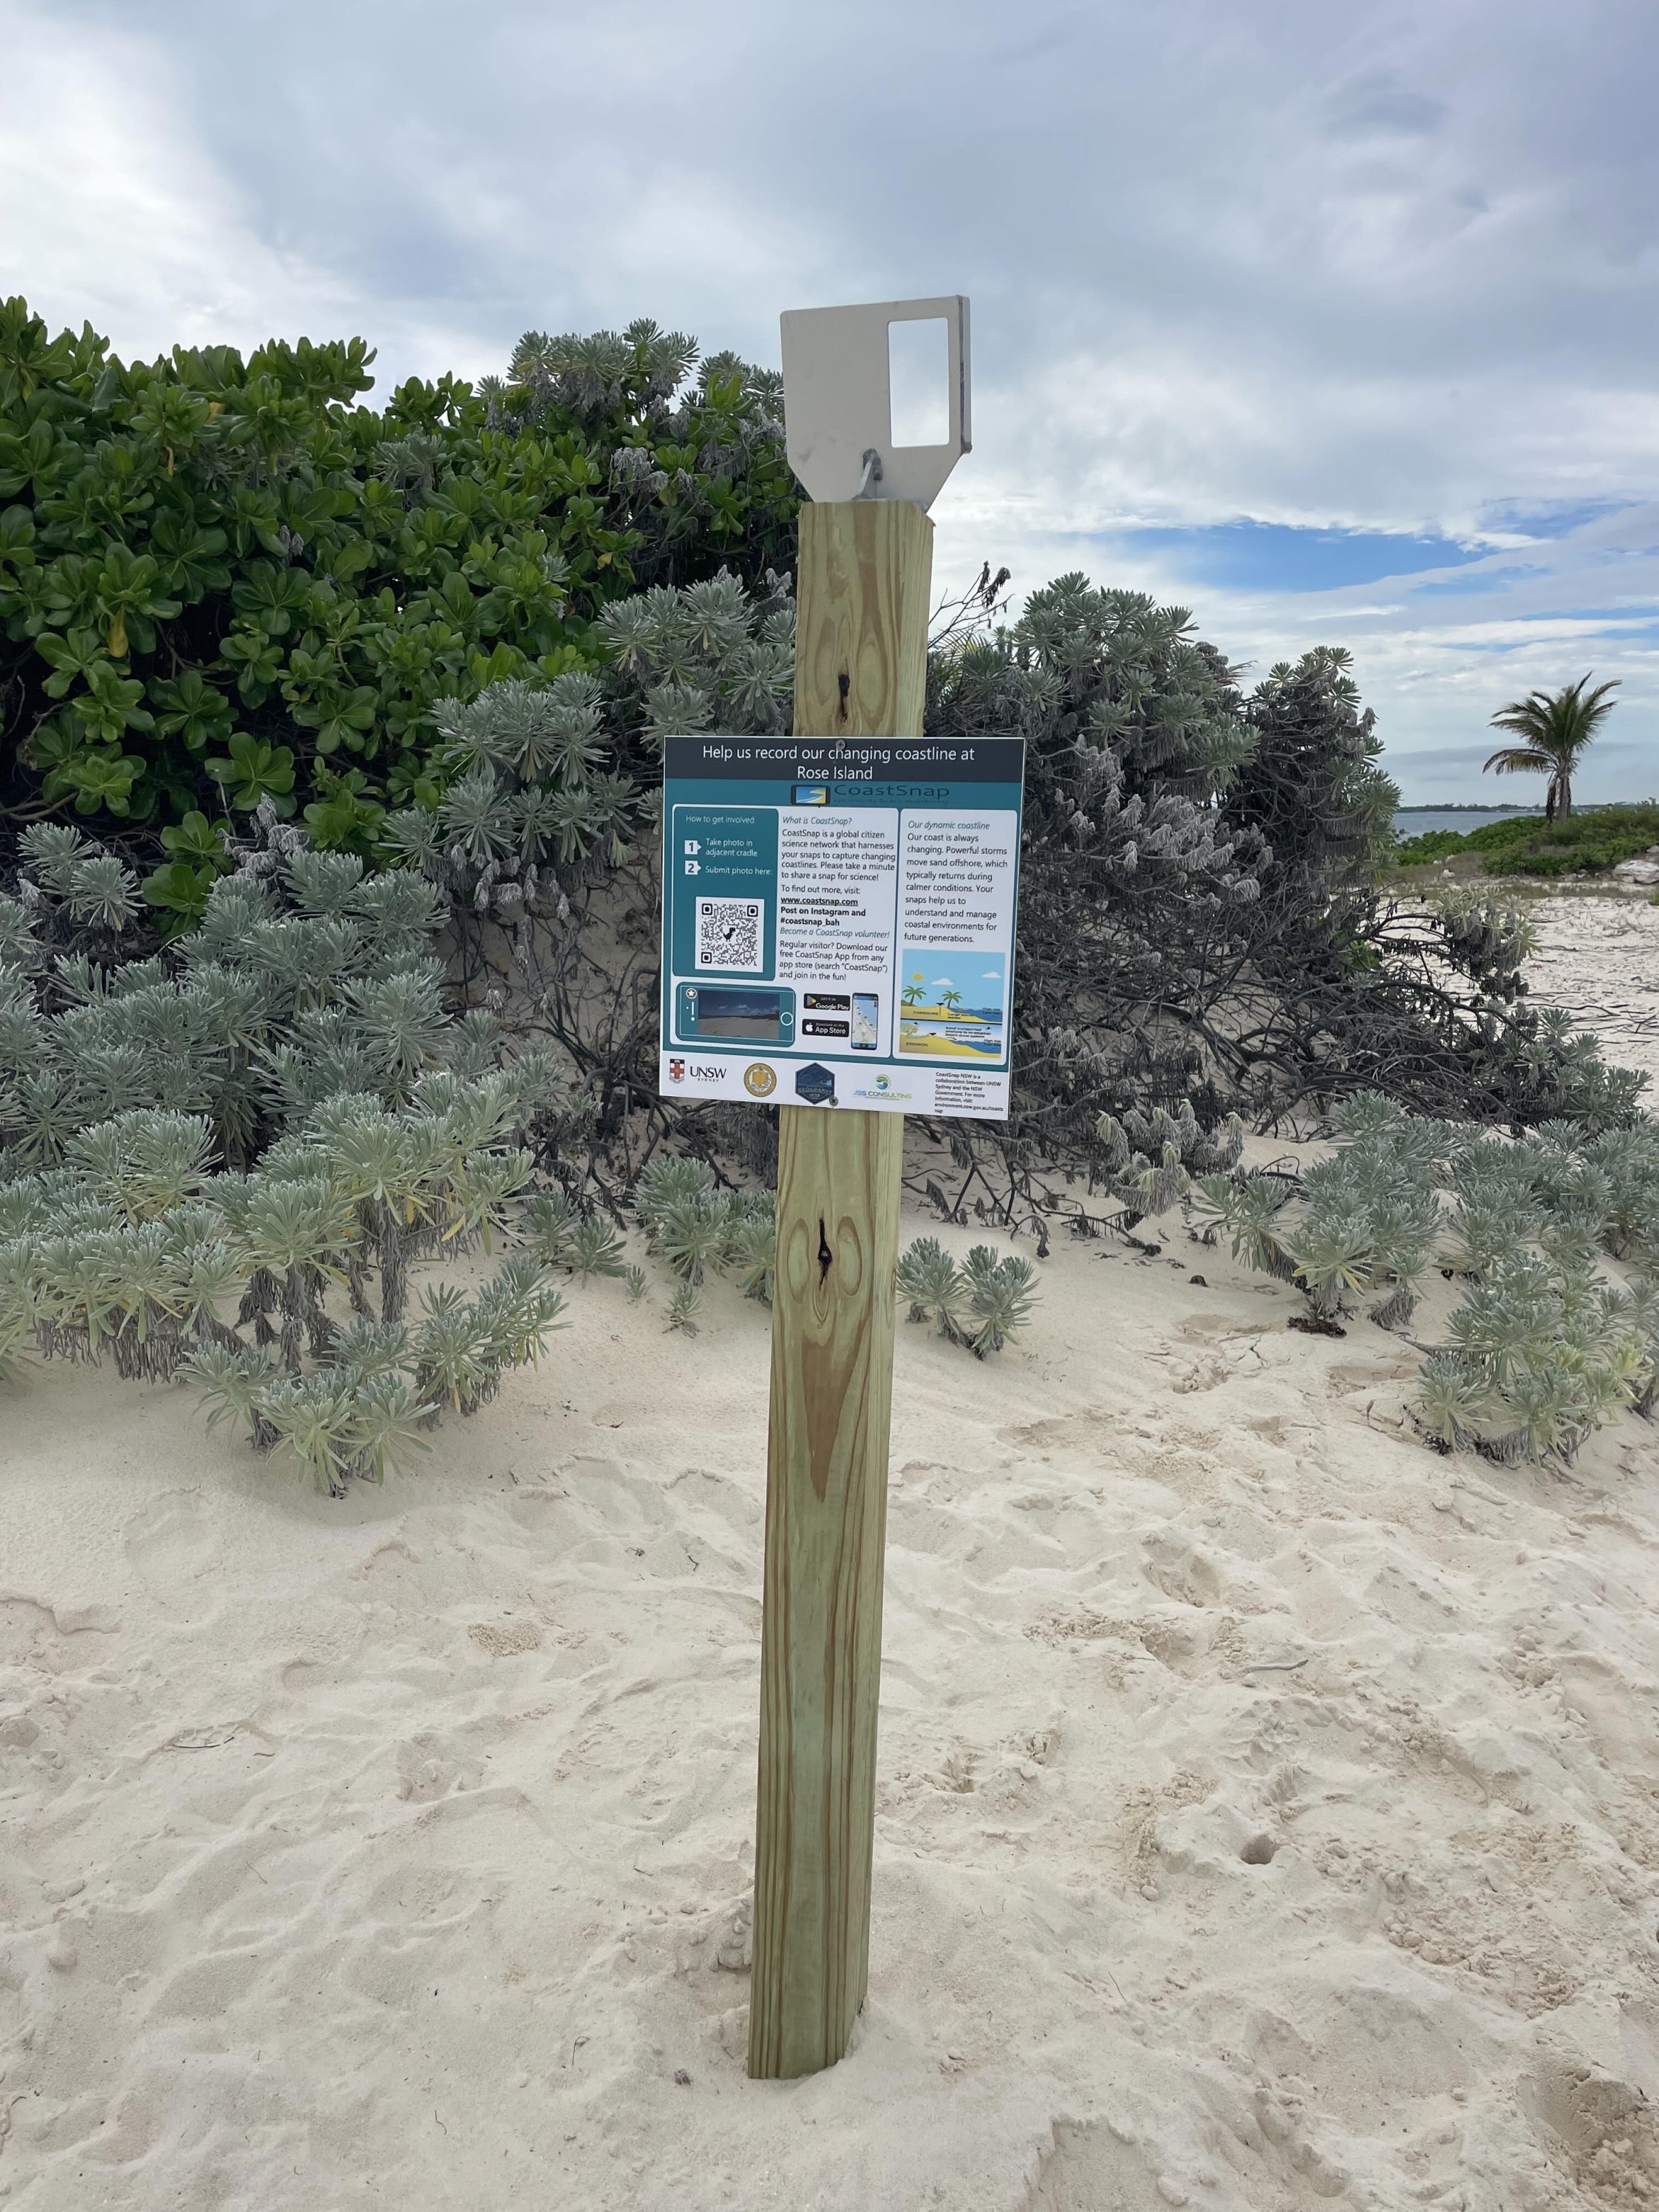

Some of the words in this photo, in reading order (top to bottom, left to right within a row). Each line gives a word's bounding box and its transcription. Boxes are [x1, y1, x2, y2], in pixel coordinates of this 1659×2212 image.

[703, 744, 732, 761] Help
[737, 748, 751, 759] us
[756, 746, 797, 759] record
[802, 749, 825, 759] our
[829, 746, 890, 763] changing
[895, 747, 956, 760] coastline
[961, 747, 975, 760] at
[798, 766, 829, 779] Rose
[834, 766, 873, 779] Island
[835, 785, 949, 798] CoastSnap
[811, 817, 851, 826] CoastSnap?
[908, 820, 922, 829] Our
[925, 821, 956, 830] dynamic
[782, 830, 820, 838] CoastSnap
[954, 834, 979, 843] always
[688, 842, 693, 852] 1
[907, 845, 944, 855] changing.
[949, 859, 983, 868] offshore,
[688, 864, 694, 873] 2
[906, 871, 937, 881] typically
[968, 873, 993, 882] during
[781, 898, 859, 906] www.coastsnap.com
[929, 896, 945, 905] help
[811, 908, 849, 917] Instagram
[905, 908, 947, 917] understand
[966, 911, 997, 920] manage
[781, 917, 839, 927] #coastsnap_bah
[816, 929, 852, 939] CoastSnap
[929, 934, 974, 943] generations.
[780, 941, 808, 949] Regular
[795, 951, 832, 960] CoastSnap
[690, 1066, 727, 1078] UNSW
